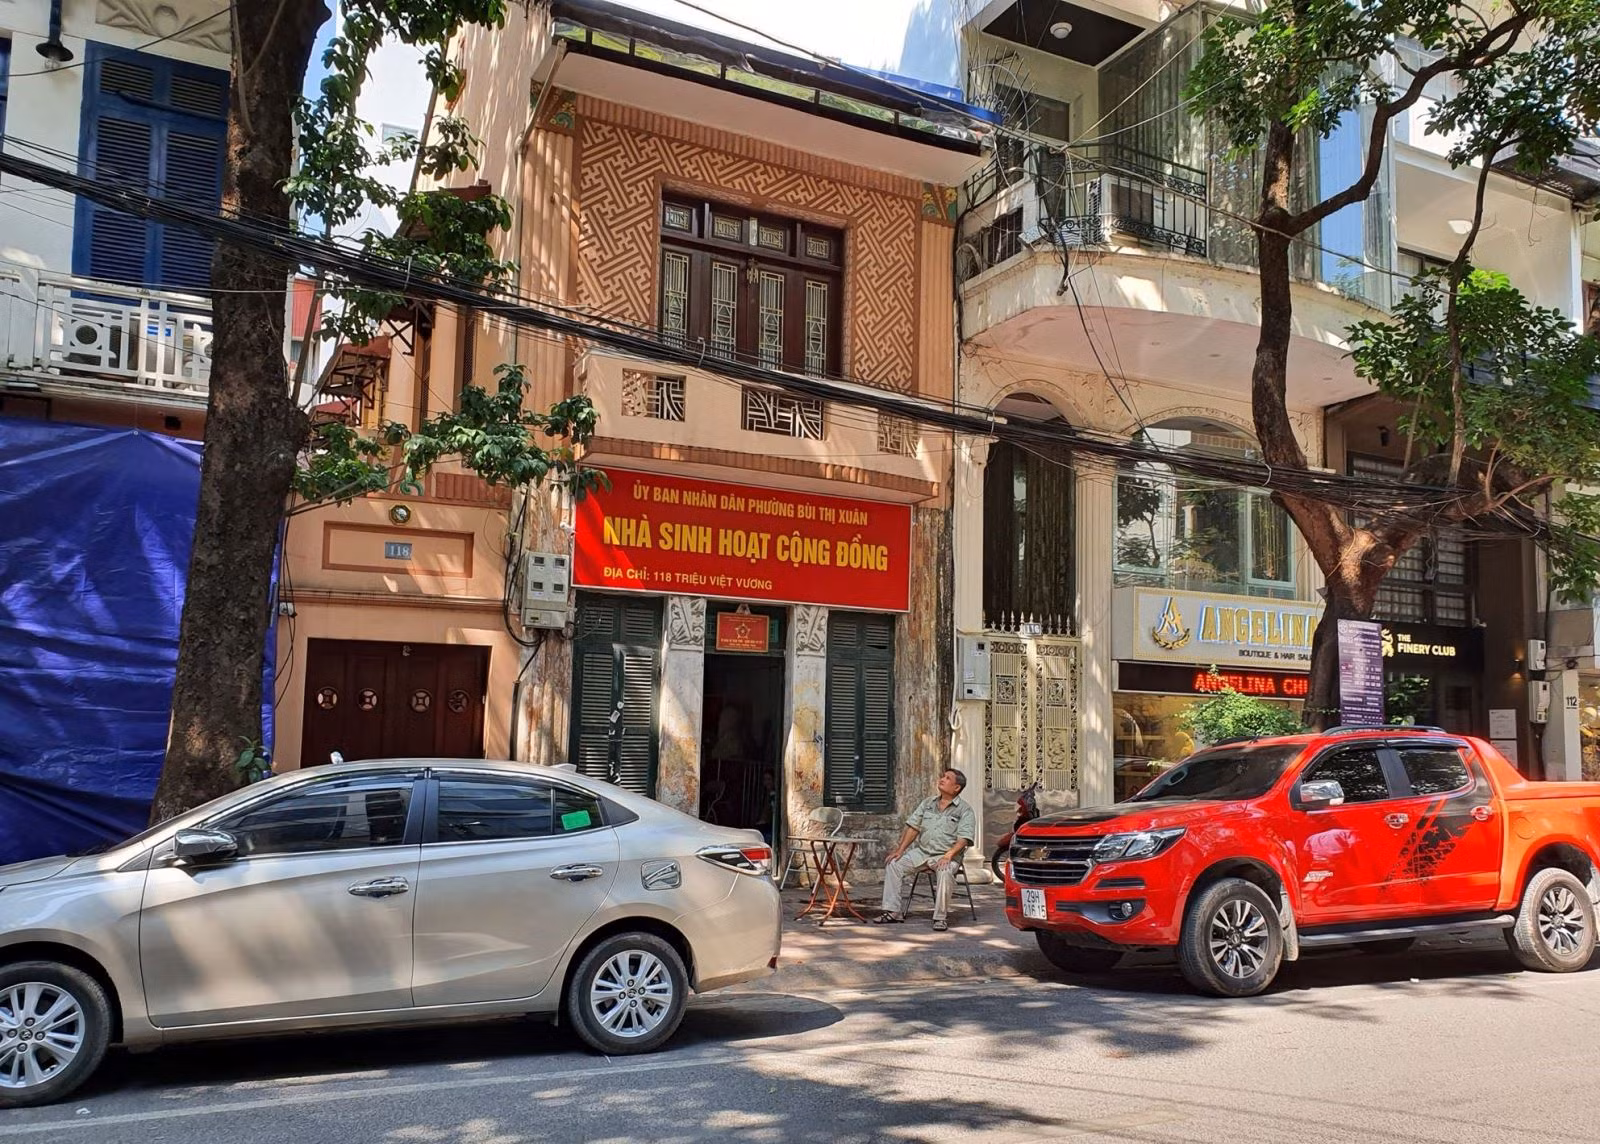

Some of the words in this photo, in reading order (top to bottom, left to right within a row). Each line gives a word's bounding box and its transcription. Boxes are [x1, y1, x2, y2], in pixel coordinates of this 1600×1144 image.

[633, 480, 650, 500] ỦY
[653, 486, 680, 504] BAN
[683, 489, 717, 508] NHÂN
[721, 493, 745, 512] DÂN
[748, 497, 795, 518] PHƯỜNG
[819, 507, 836, 525] THỊ
[838, 508, 868, 526] XUÂN
[603, 514, 652, 548] NHÀ
[659, 522, 712, 554] SINH
[718, 528, 771, 563] HOẠT
[776, 530, 831, 568] CỘNG
[836, 533, 889, 571] ĐỒNG
[390, 545, 410, 556] 118
[603, 567, 623, 580] ĐỊA
[626, 567, 650, 581] CHỈ:
[653, 572, 672, 582] 118
[675, 572, 707, 585] TRIỆU
[709, 574, 733, 588] VIỆT
[736, 577, 773, 590] VƯƠNG
[1397, 633, 1411, 642] THE
[1238, 650, 1272, 659] BOUTIQUE
[1280, 652, 1296, 660] HAIR
[1297, 653, 1312, 661] SAL
[1397, 643, 1431, 655] FINERY
[1431, 645, 1456, 656] CLUB
[1566, 696, 1577, 706] 112
